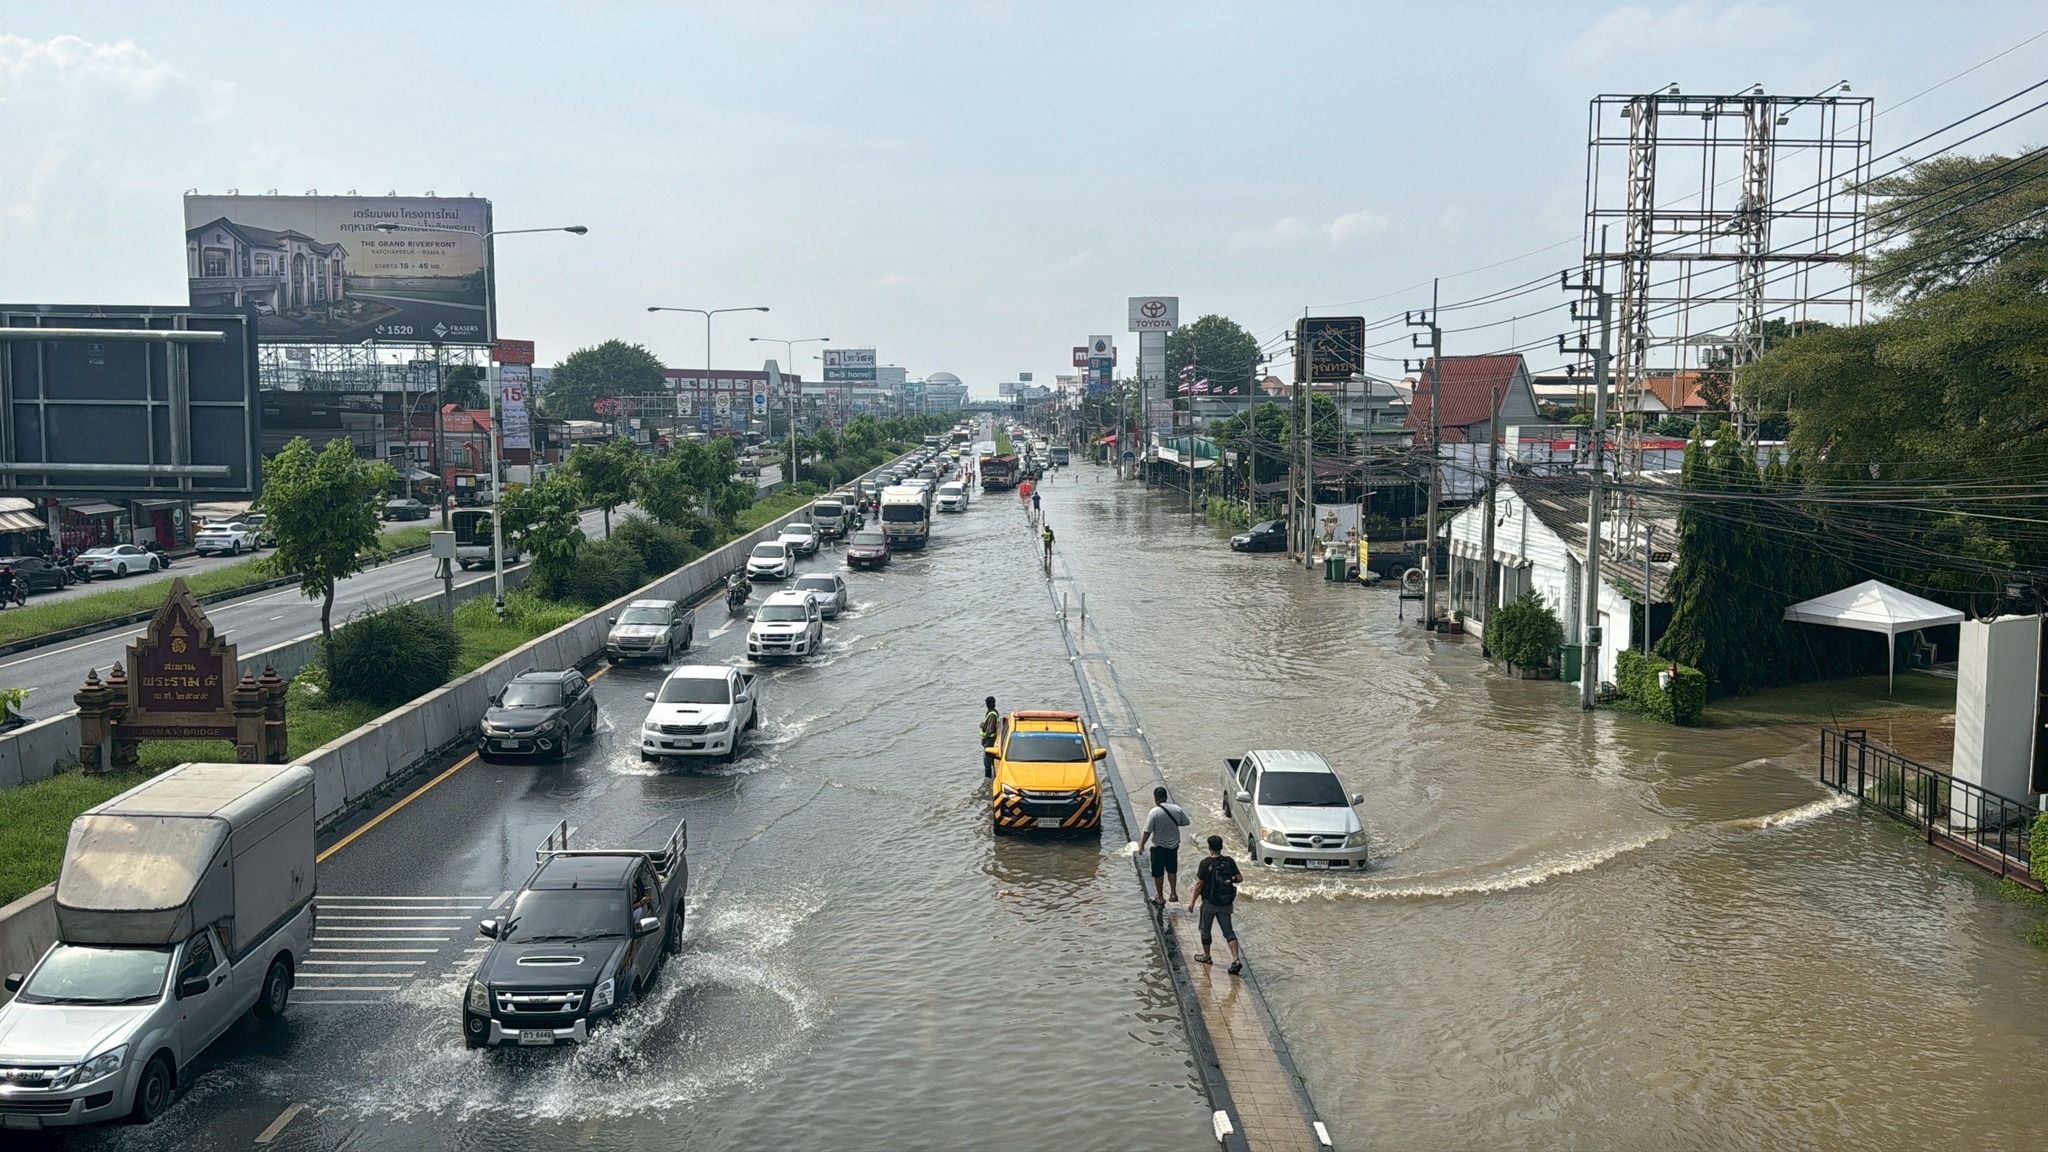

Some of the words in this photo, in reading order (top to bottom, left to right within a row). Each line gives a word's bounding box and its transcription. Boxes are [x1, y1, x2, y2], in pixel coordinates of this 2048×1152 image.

[353, 208, 399, 219] เตรียมพบ
[400, 207, 459, 219] โครงการใหม่
[361, 240, 375, 248] THE
[378, 240, 405, 248] GRAND
[407, 240, 456, 248] RIVERFRONT
[1135, 319, 1172, 328] TOYOTA
[387, 325, 414, 335] 1520
[164, 661, 197, 671] สะพาน
[143, 676, 200, 687] พระราม
[204, 674, 218, 687] ๕
[183, 728, 221, 736] BRIDGE
